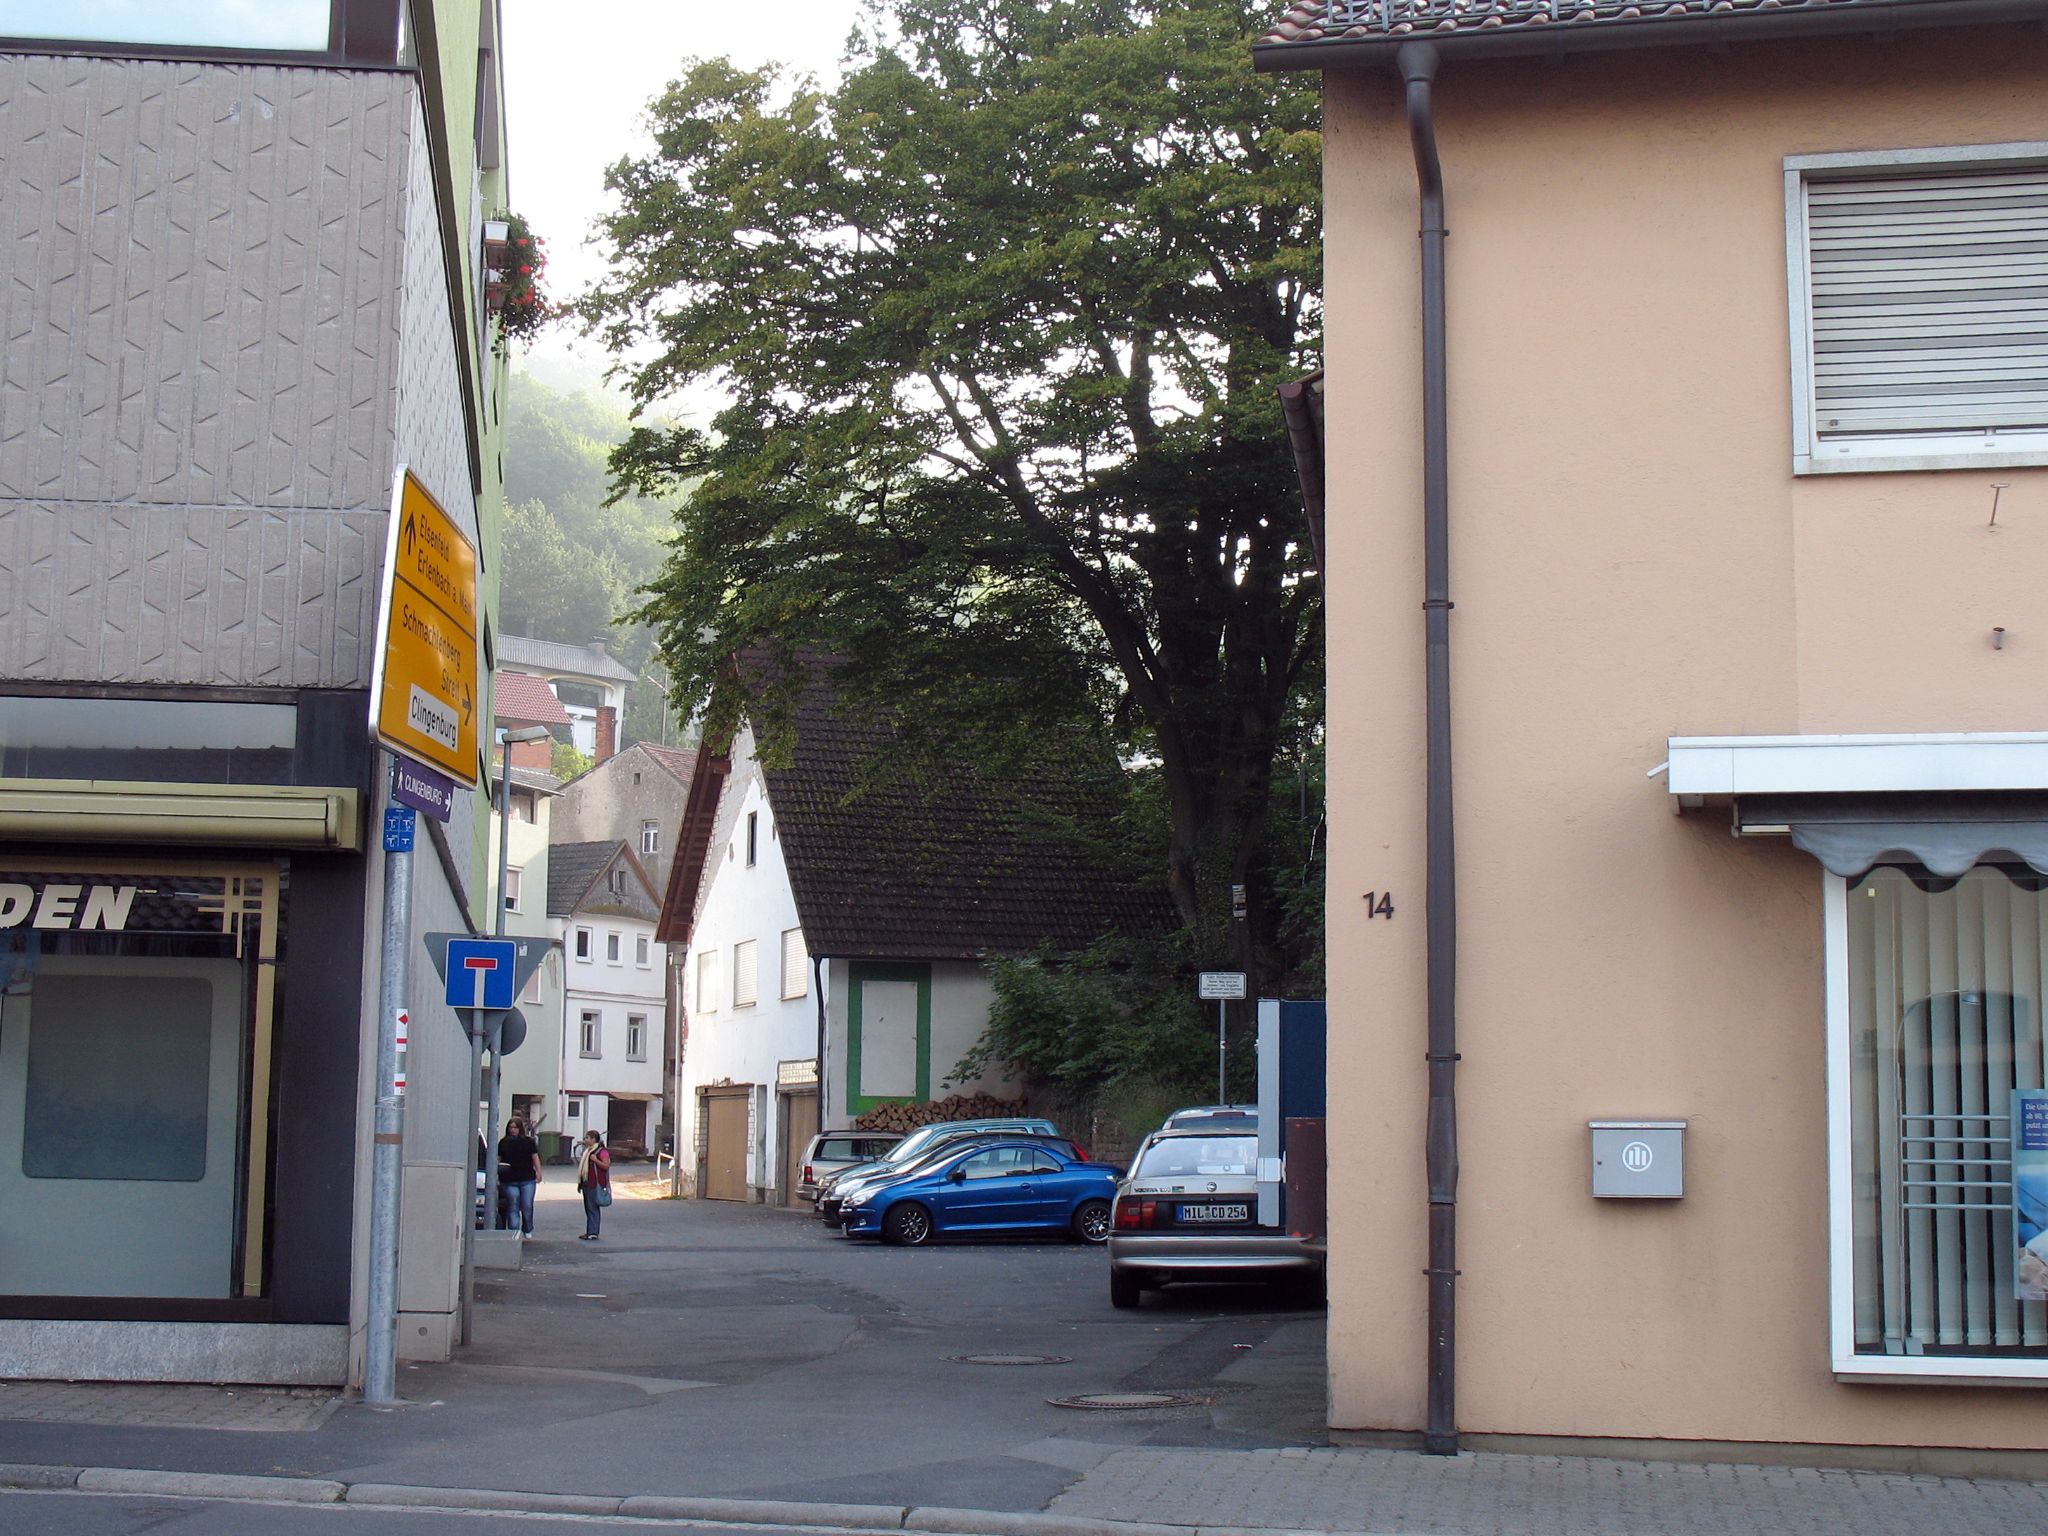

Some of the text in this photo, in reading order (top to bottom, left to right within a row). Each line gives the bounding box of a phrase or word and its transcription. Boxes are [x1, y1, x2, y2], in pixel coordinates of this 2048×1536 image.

[420, 514, 449, 562] Elsenfeld
[418, 548, 450, 598] Erlenbach
[403, 605, 460, 672] Schmachtenberg
[442, 668, 460, 702] Streit
[411, 695, 457, 748] Clingenburg
[405, 774, 442, 806] CLINGENBURG
[1363, 891, 1394, 919] 14
[1184, 1206, 1246, 1219] MIL CD 254
